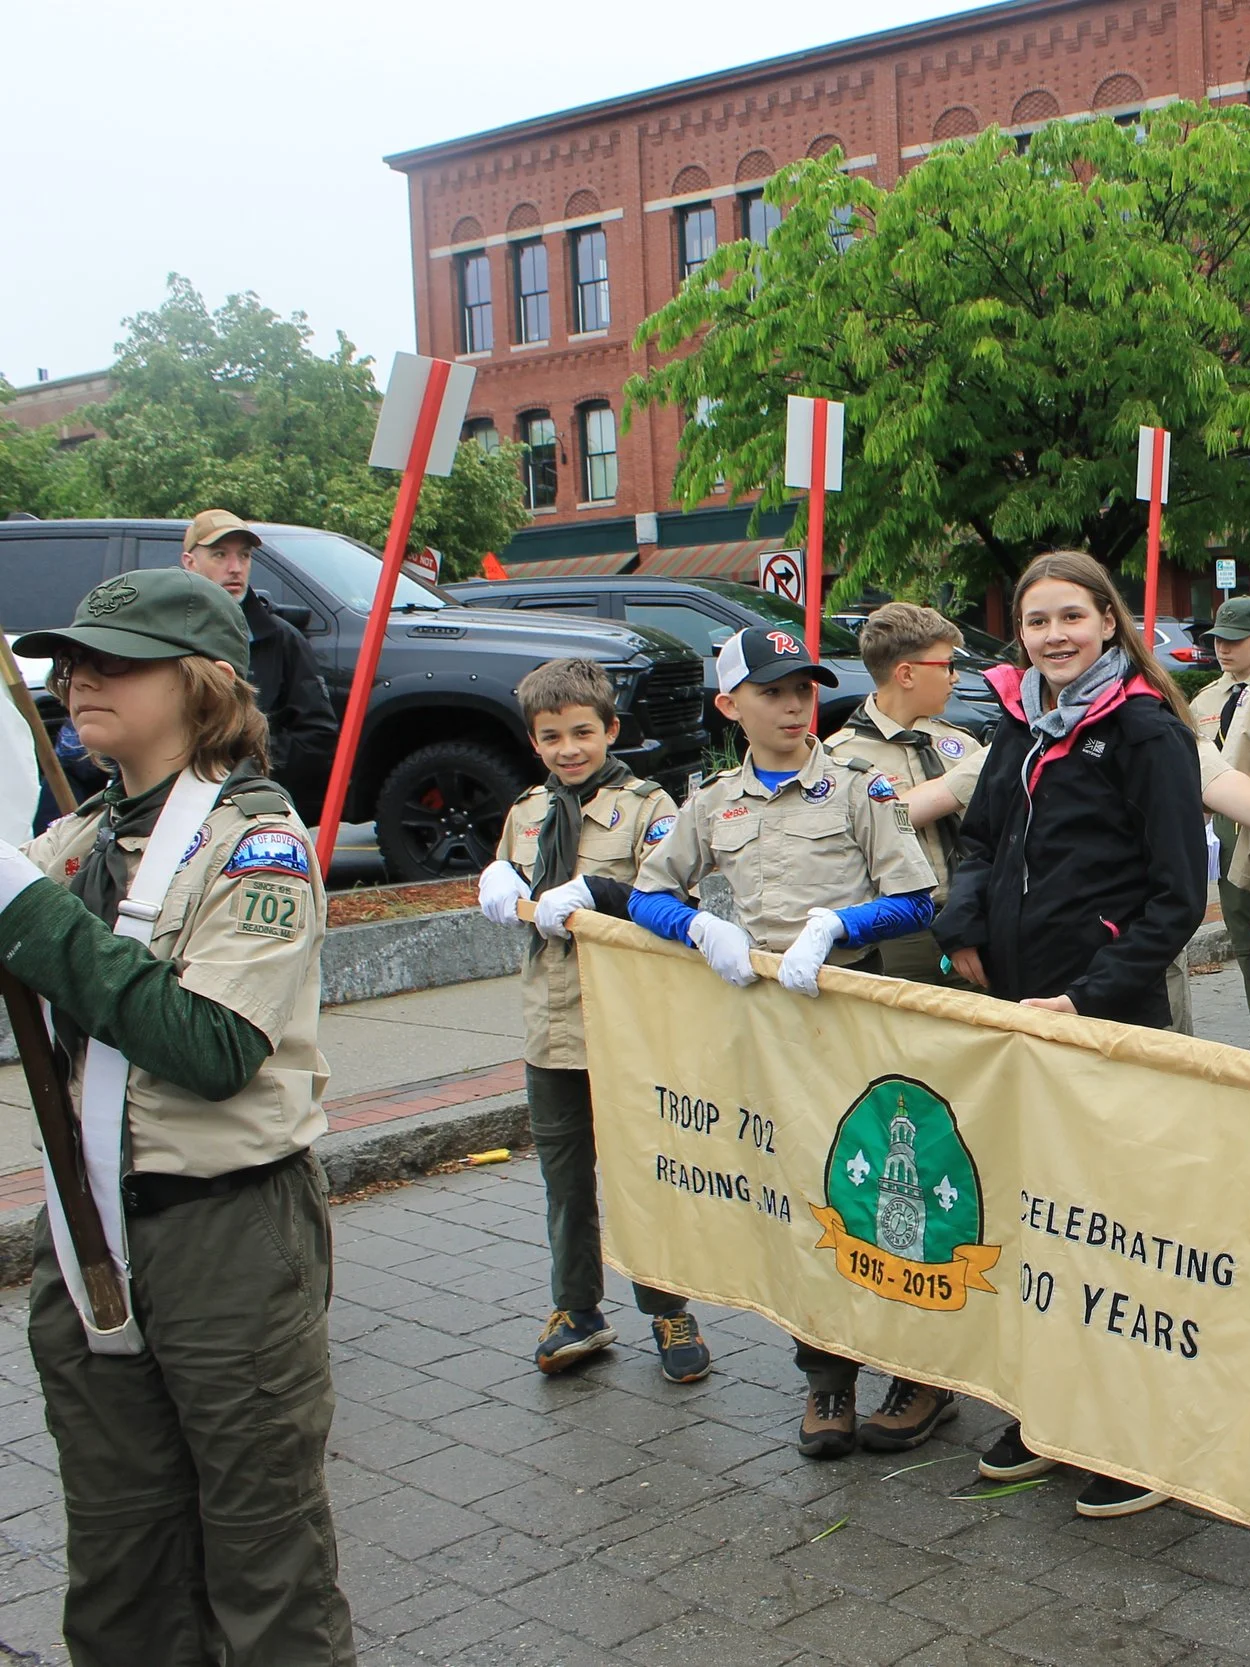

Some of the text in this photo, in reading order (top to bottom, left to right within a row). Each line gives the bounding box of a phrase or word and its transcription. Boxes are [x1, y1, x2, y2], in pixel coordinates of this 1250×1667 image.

[421, 556, 434, 567] NOT
[766, 631, 800, 655] R
[733, 807, 748, 817] BSA
[253, 882, 276, 892] SINCE
[246, 891, 296, 928] 702
[655, 1086, 775, 1153] TROOP 702
[850, 1250, 885, 1285] 1915
[903, 1268, 952, 1300] 2015
[1083, 1284, 1199, 1359] YEARS
